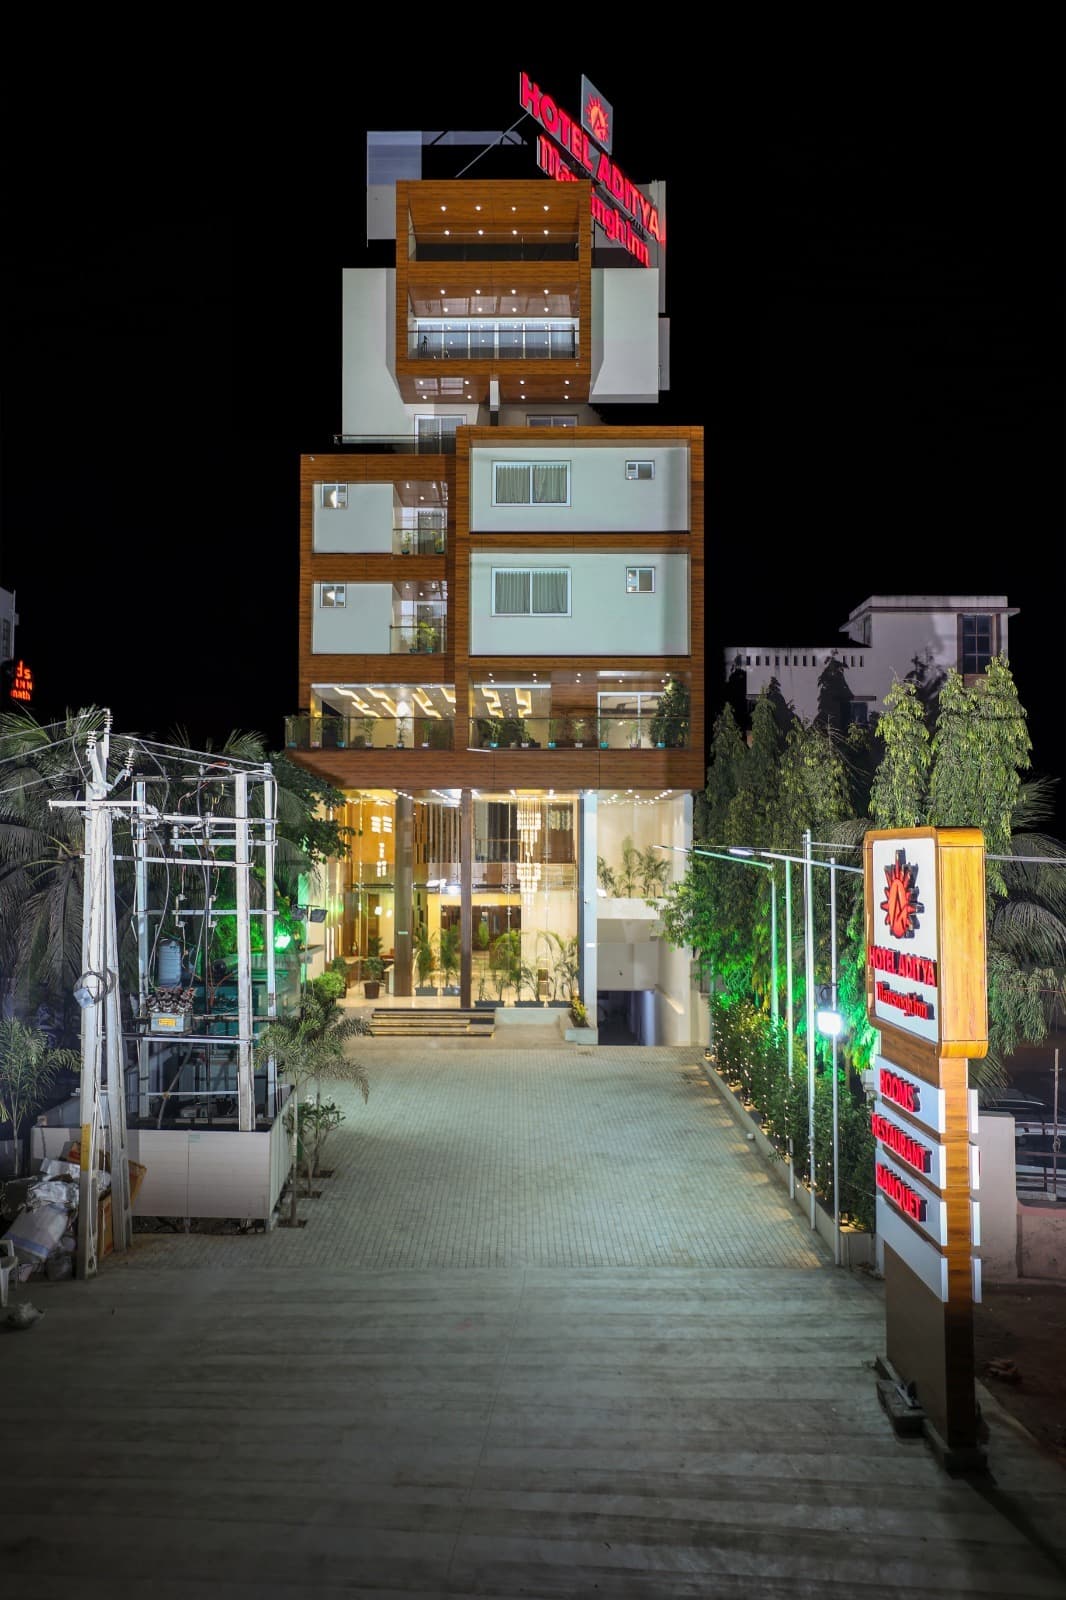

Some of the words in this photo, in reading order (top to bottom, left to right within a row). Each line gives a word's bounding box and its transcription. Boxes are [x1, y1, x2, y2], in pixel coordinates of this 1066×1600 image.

[522, 71, 594, 171] HOTEL
[597, 154, 660, 241] ADITYA
[868, 945, 896, 974] HOTEL
[898, 952, 936, 987] ADITYA
[879, 1067, 917, 1112] ROOMS
[871, 1111, 926, 1173] RESTAURANT
[875, 1162, 922, 1222] BANQUET
